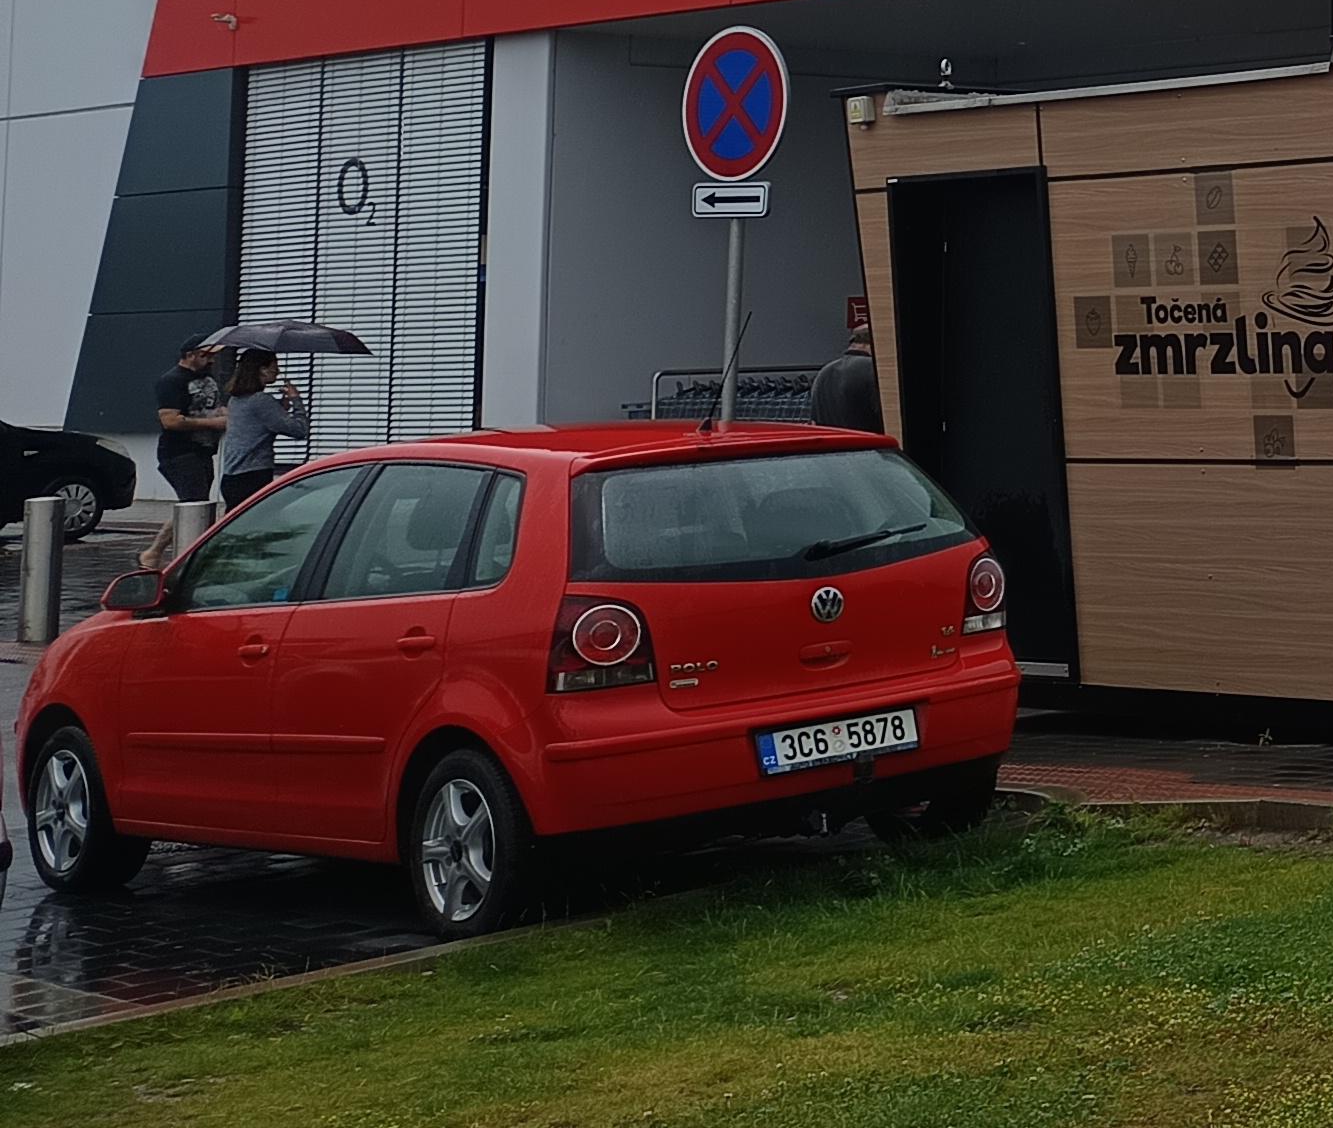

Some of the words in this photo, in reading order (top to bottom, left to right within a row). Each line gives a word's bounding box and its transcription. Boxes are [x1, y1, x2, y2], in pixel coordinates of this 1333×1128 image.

[1140, 296, 1228, 324] Točená
[670, 660, 719, 673] POLO
[781, 728, 829, 761] 3C6
[846, 715, 905, 749] 5878
[763, 755, 777, 765] CZ
